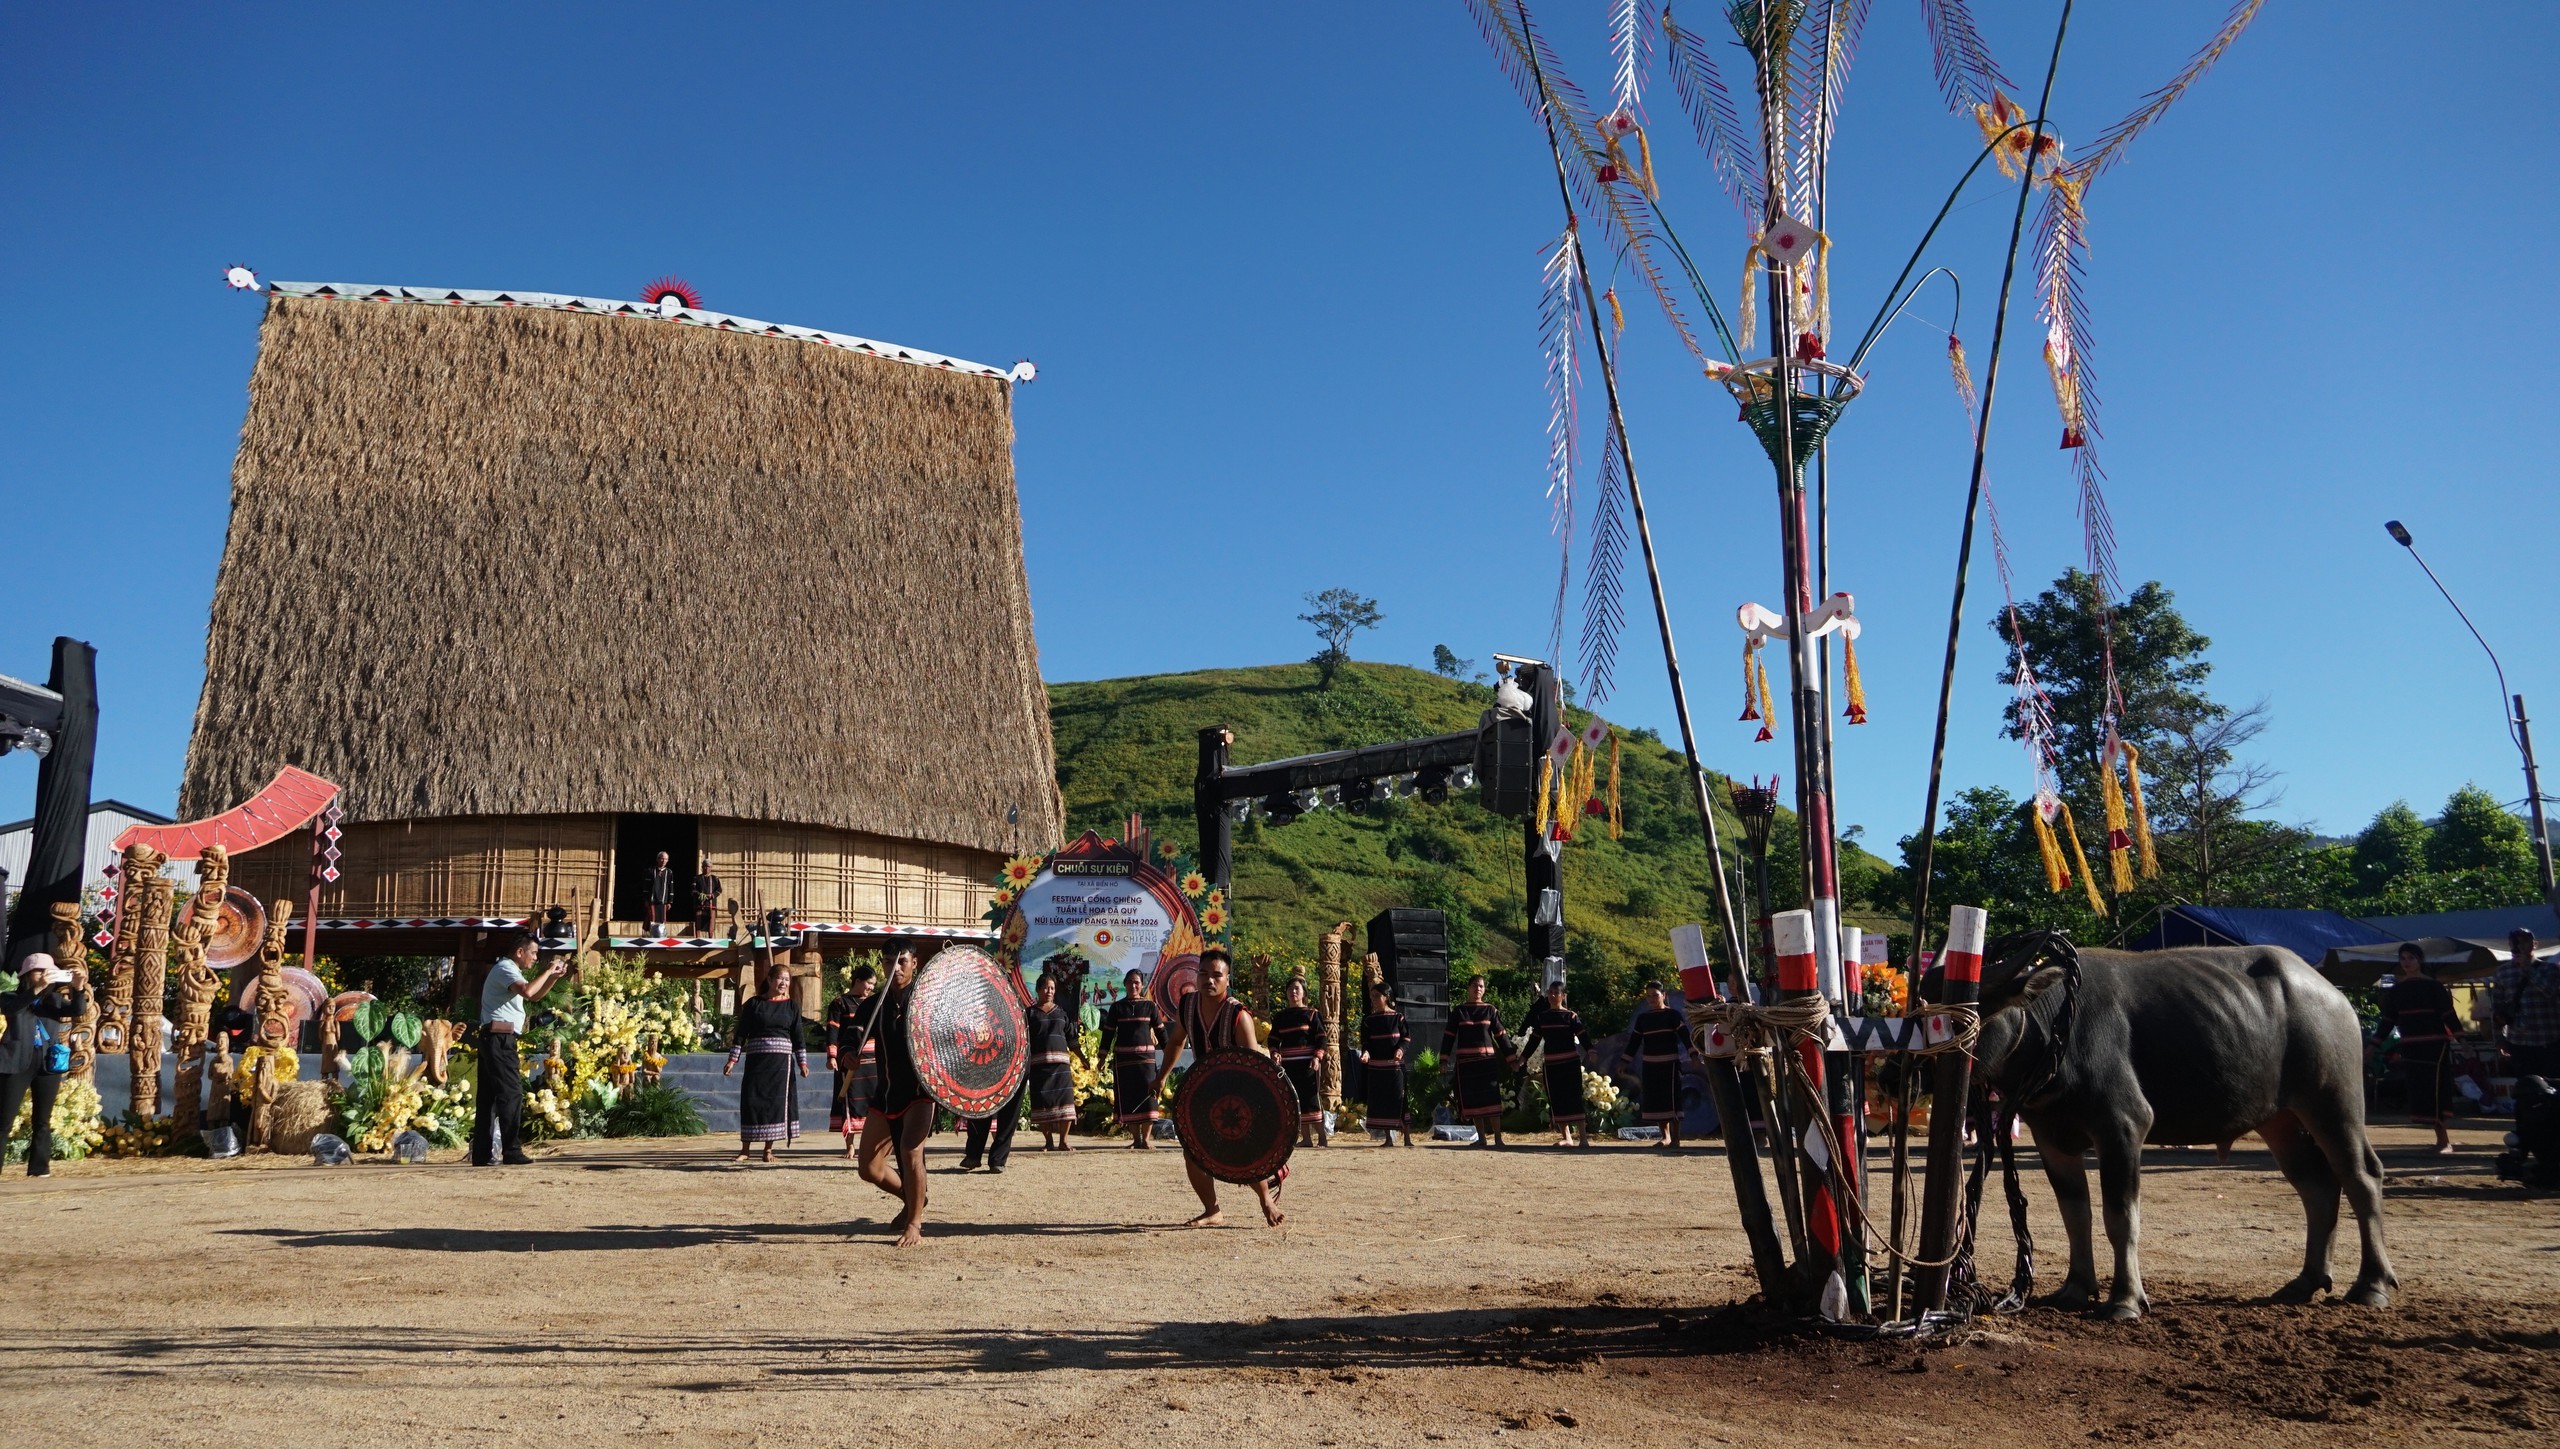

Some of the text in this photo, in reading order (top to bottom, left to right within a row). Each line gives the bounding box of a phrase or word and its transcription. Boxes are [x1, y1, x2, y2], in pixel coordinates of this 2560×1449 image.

[1057, 862, 1129, 875] CHUỖI SỰ KIỆN
[1052, 895, 1085, 903] FESTIVAL
[1113, 895, 1142, 904] CHIÊNG
[1089, 906, 1105, 914] HOA
[1120, 905, 1137, 914] QUỲ
[1034, 915, 1047, 924] NÚI
[1049, 915, 1064, 924] LỬA
[1121, 916, 1139, 925] NĂM
